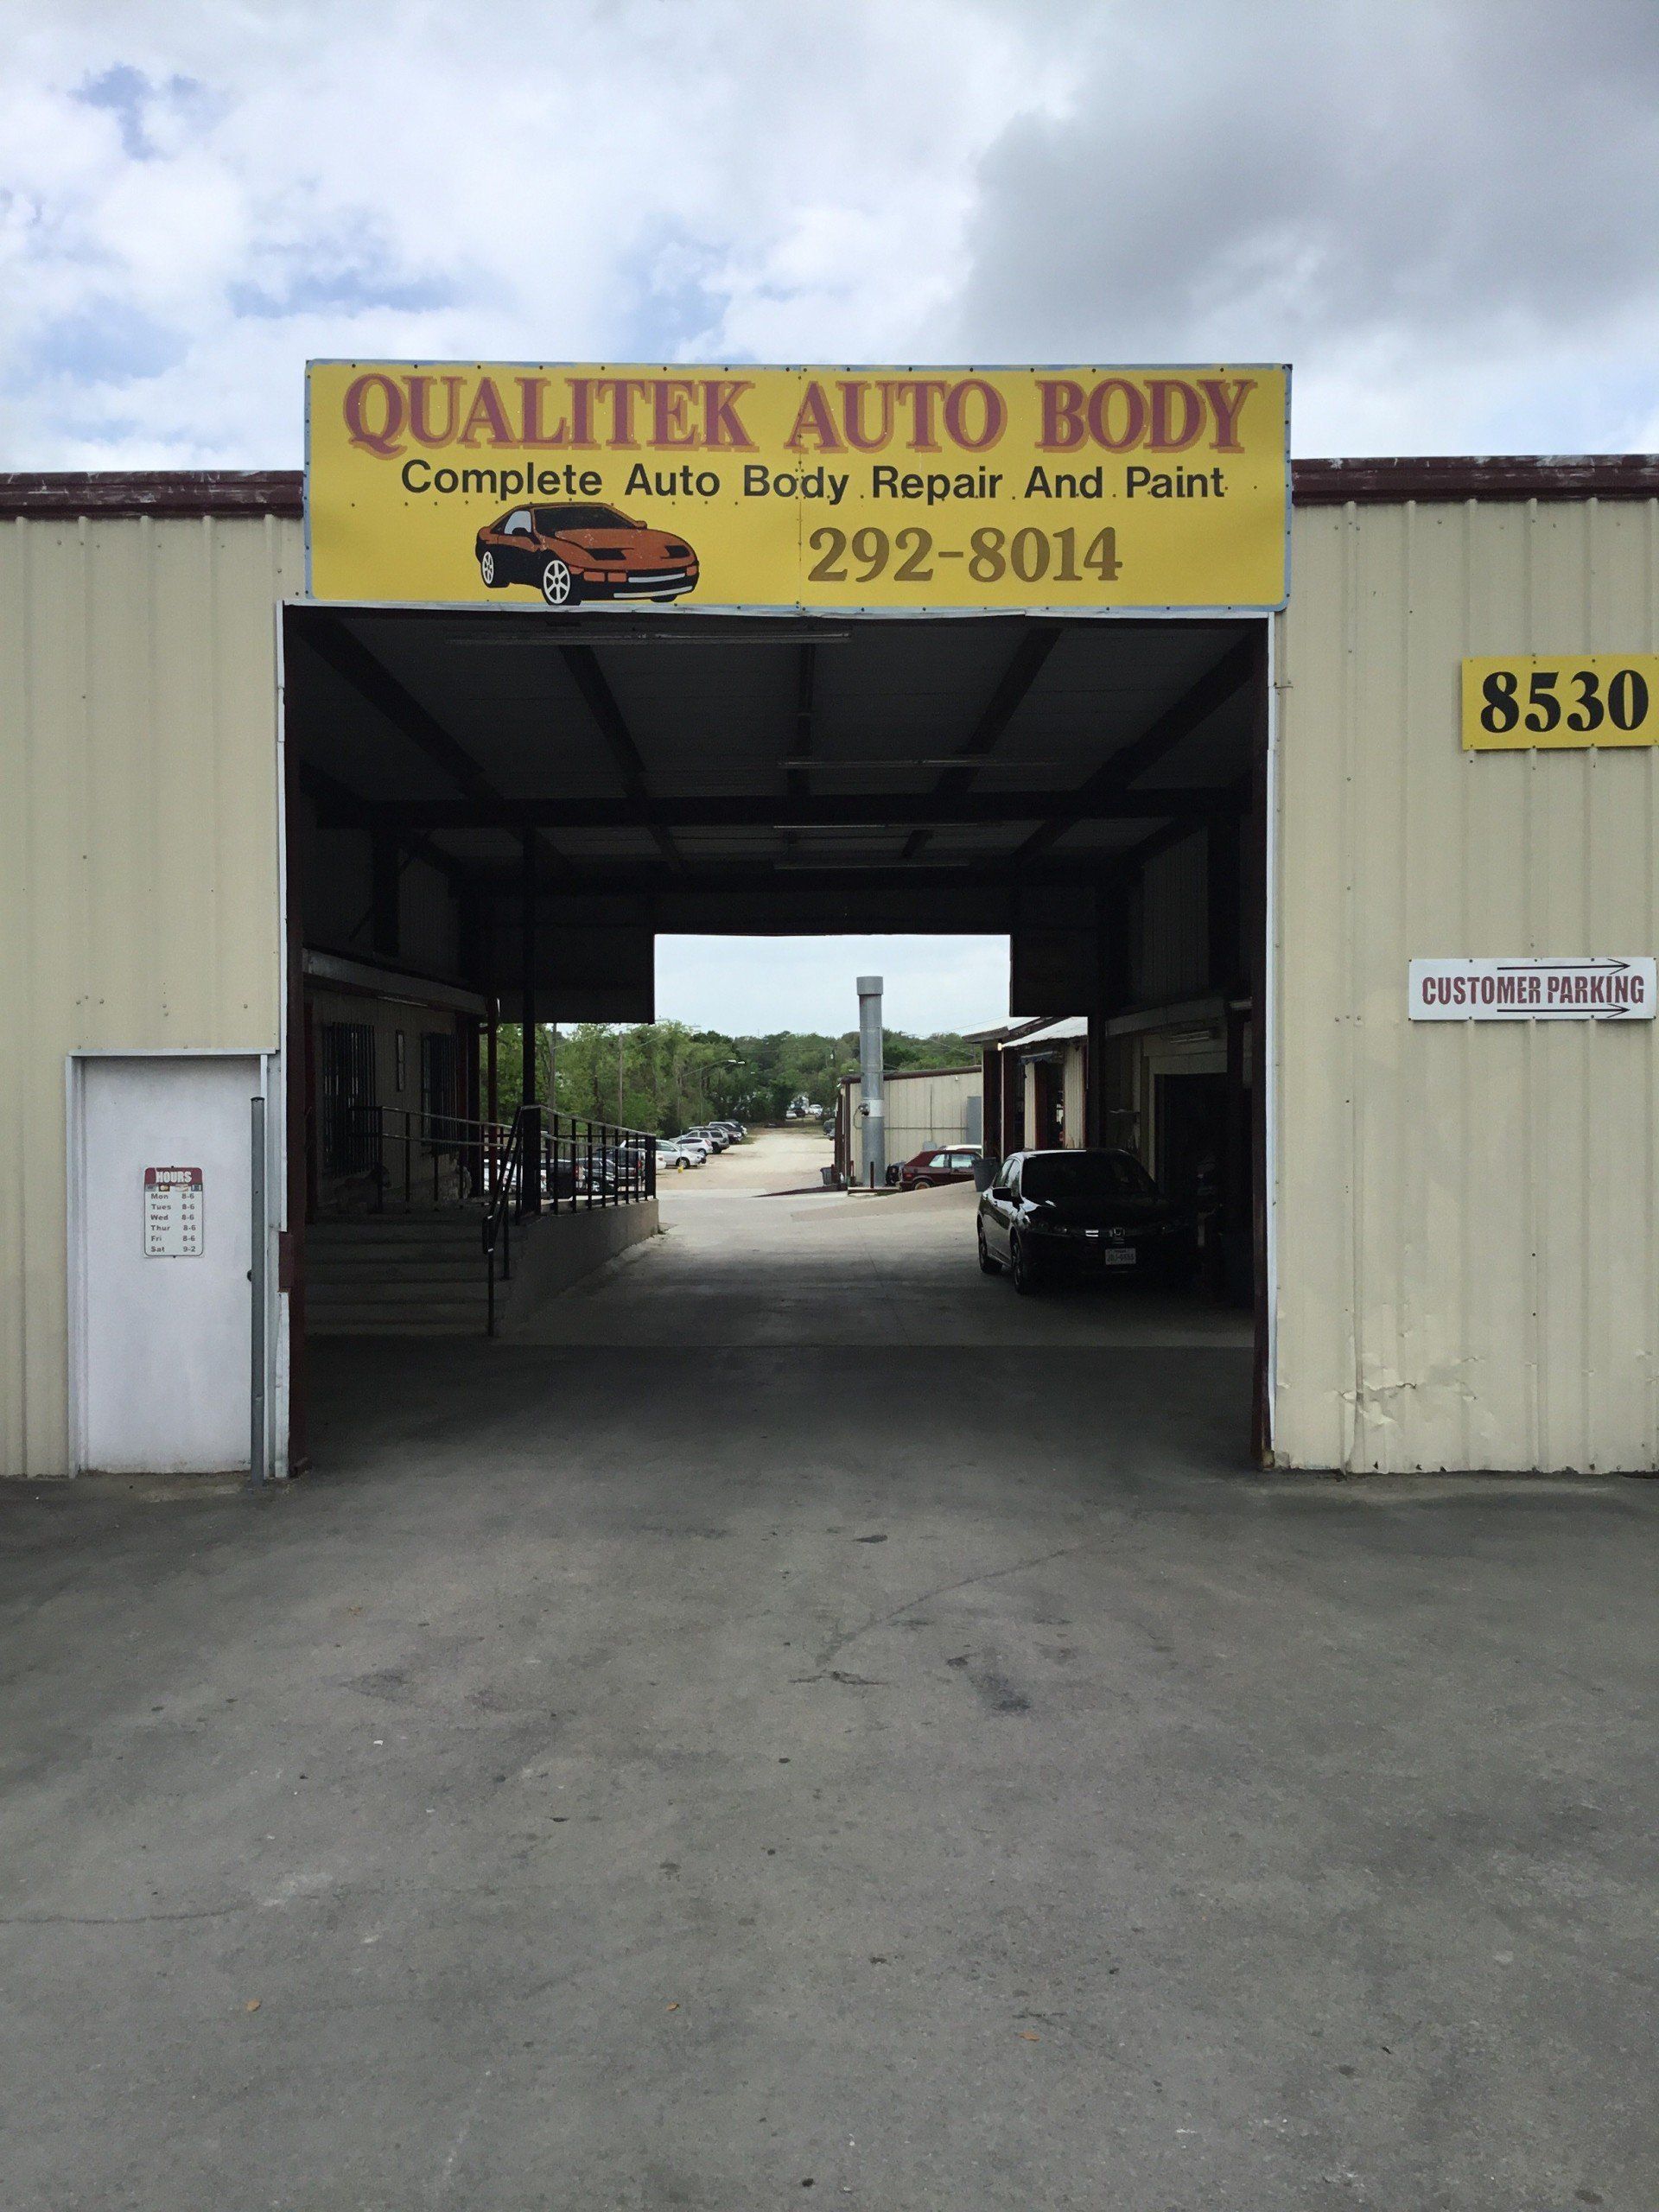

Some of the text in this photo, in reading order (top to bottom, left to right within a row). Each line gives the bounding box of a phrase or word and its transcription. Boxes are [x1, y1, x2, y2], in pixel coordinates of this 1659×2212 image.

[343, 372, 1258, 460] QUALITEK AUTO BODY
[402, 459, 1225, 506] Complete Auto Body Repair And Paint
[808, 526, 1123, 583] 292-8014
[1480, 669, 1649, 734] 8530
[1421, 975, 1644, 1006] CUSTOMER PARKING
[156, 1171, 193, 1184] HOURS
